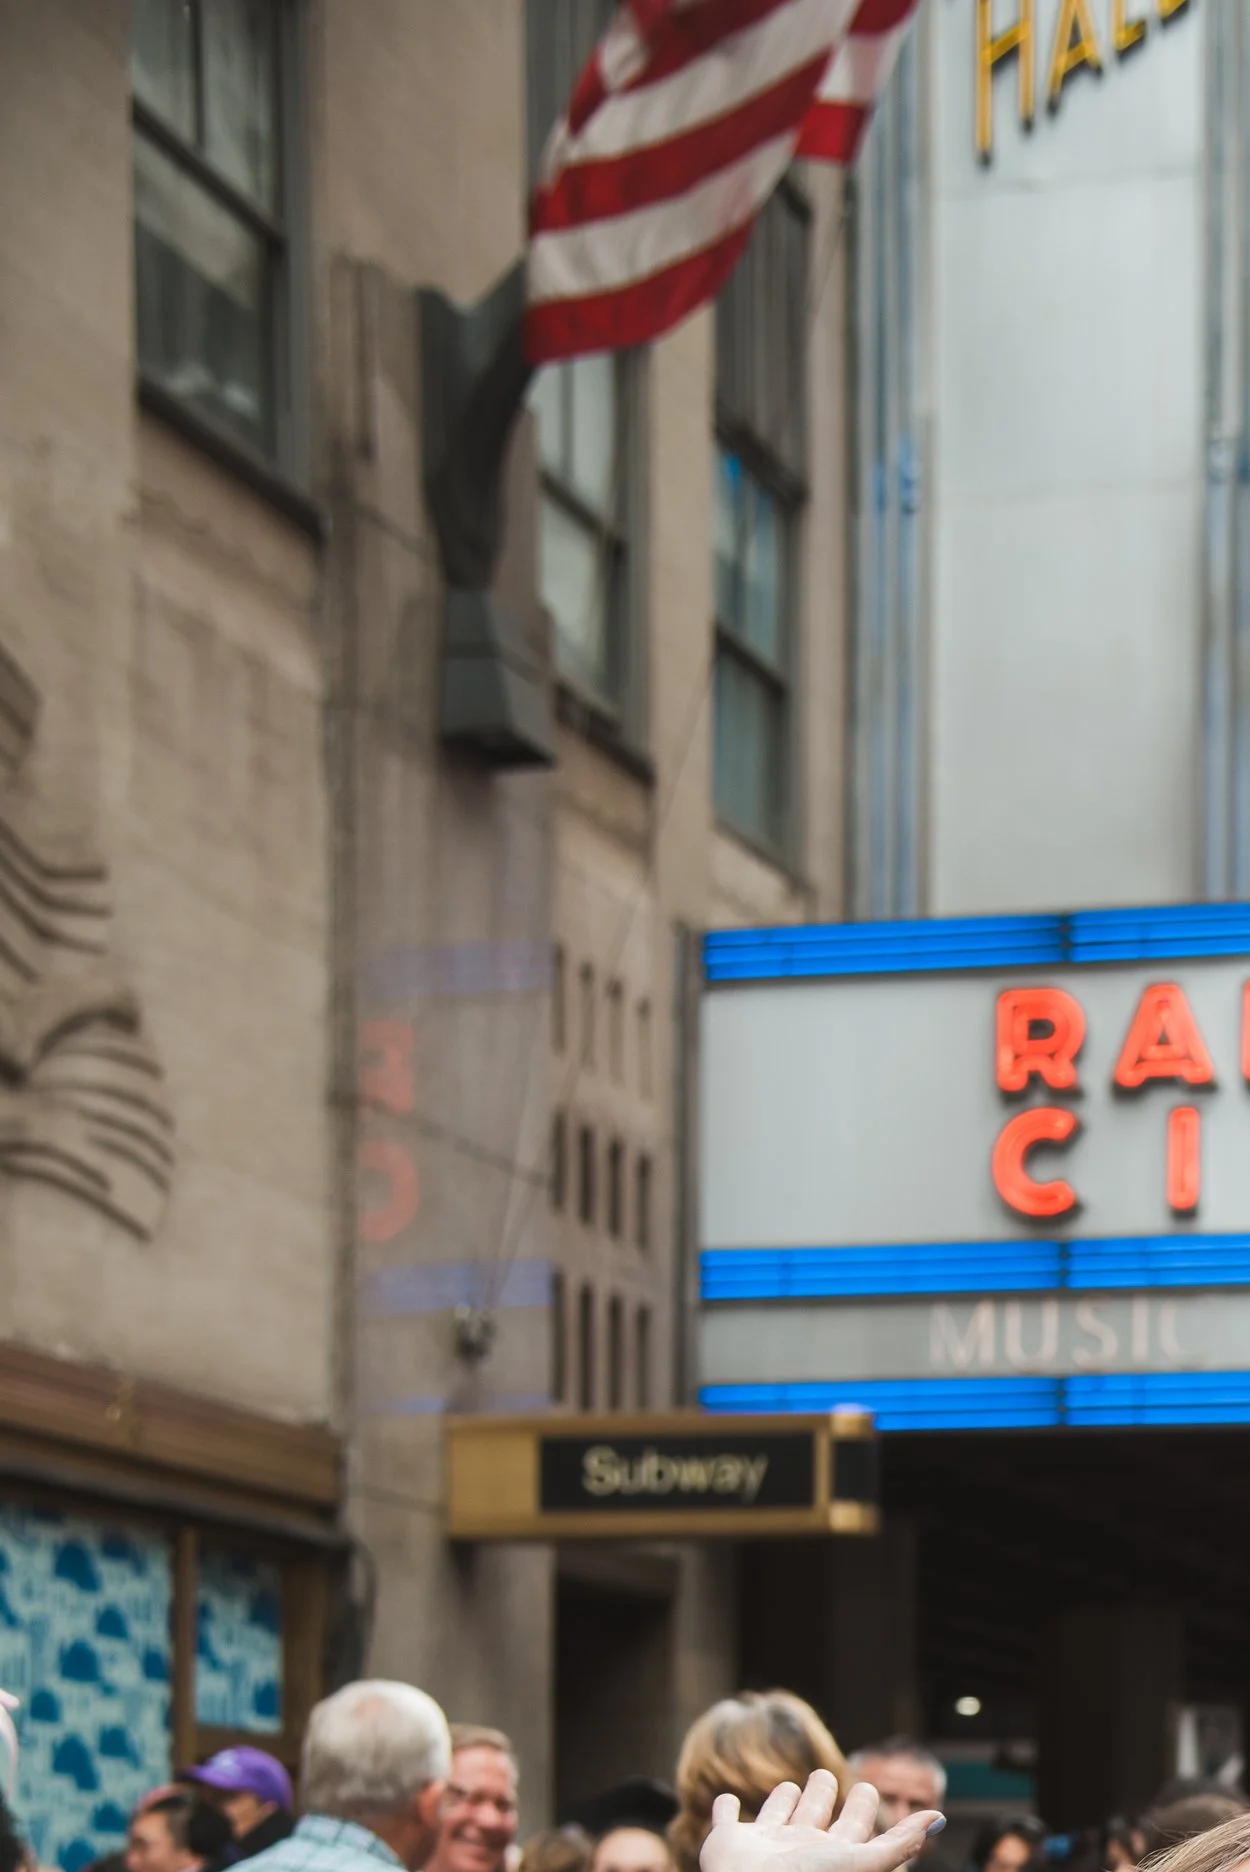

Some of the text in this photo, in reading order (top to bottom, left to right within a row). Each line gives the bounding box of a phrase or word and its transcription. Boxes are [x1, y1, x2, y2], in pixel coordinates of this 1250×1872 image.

[976, 0, 1192, 162] HA
[928, 1296, 1203, 1370] MUSIC
[582, 1444, 768, 1501] Subway
